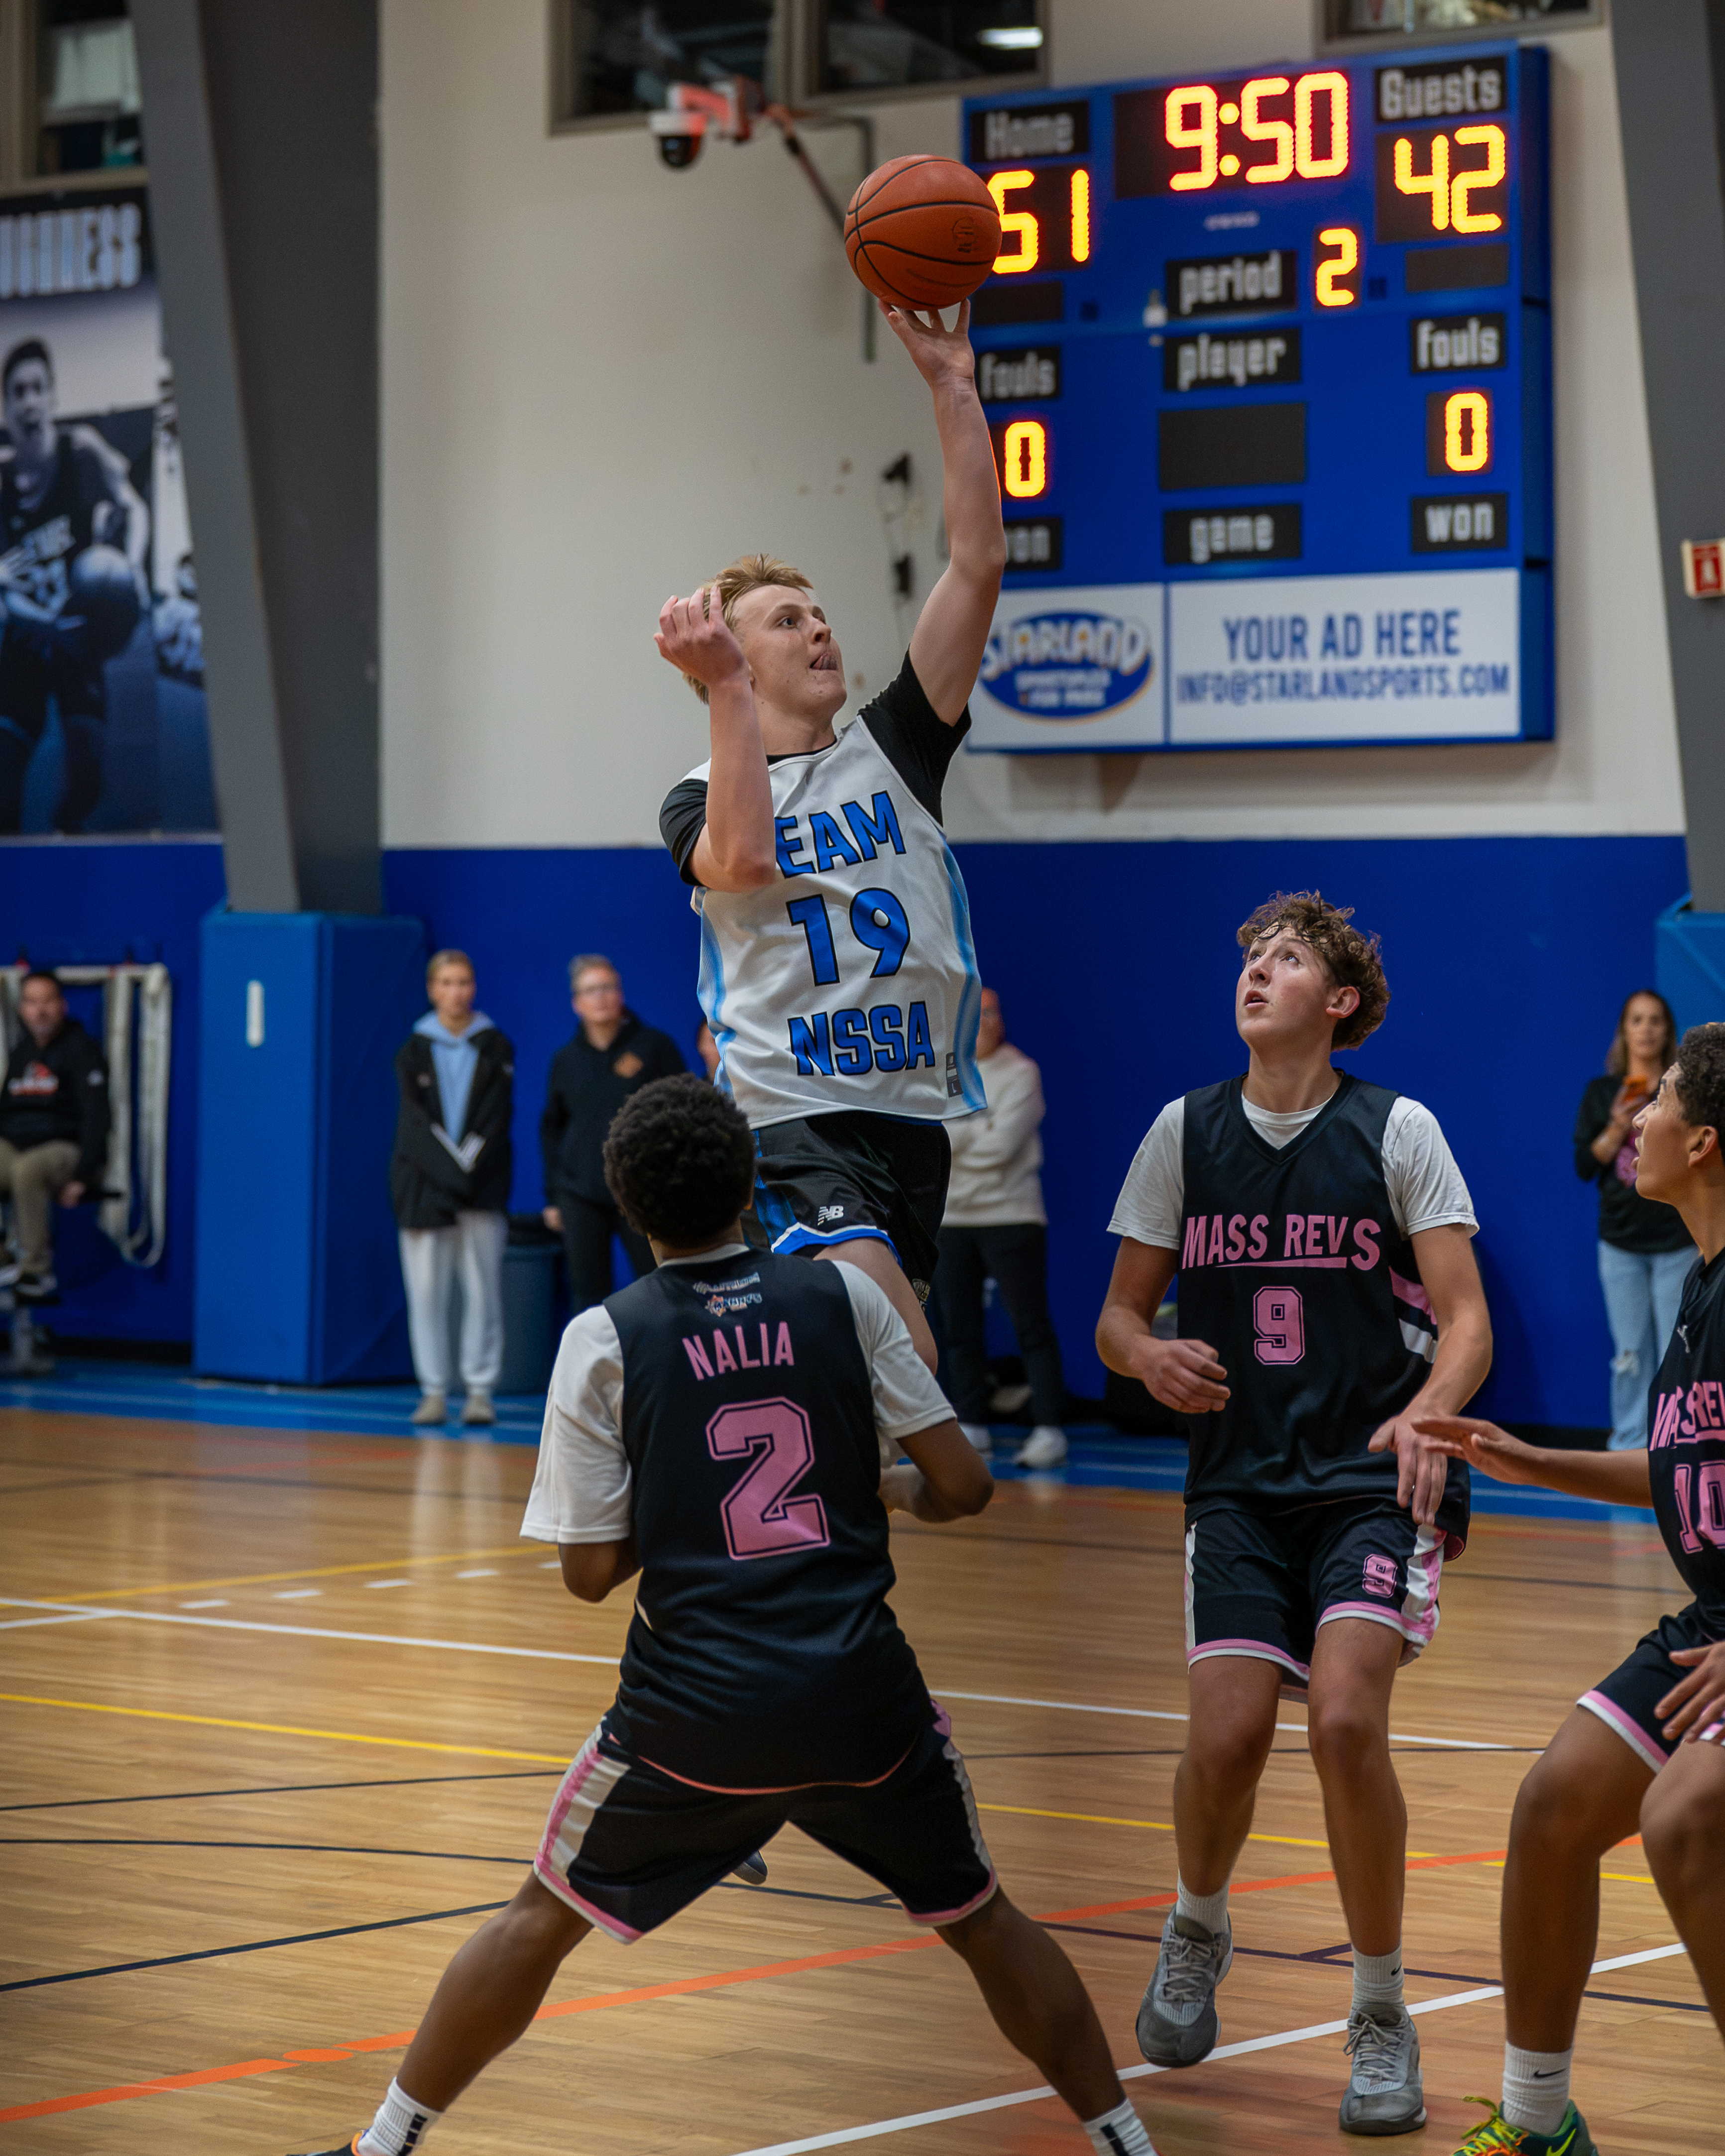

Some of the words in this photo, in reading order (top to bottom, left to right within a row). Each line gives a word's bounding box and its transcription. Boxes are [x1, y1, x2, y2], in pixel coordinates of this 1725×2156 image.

[1380, 65, 1501, 120] Guests
[984, 112, 1074, 159] Home
[1165, 72, 1349, 191] 9:50
[1394, 124, 1505, 233] 42
[986, 169, 1089, 274] 51
[1179, 249, 1282, 315] period
[1316, 227, 1358, 307] 2
[979, 351, 1056, 399] fouls
[1177, 332, 1286, 392] player
[1416, 317, 1500, 369] fouls
[1004, 421, 1045, 497] 0
[1445, 392, 1488, 471] 0
[1004, 524, 1051, 564] on
[1189, 513, 1274, 564] game
[1424, 502, 1494, 543] won
[1223, 615, 1309, 663] YOUR
[1320, 612, 1363, 660] AD
[1375, 608, 1461, 658] HERE
[775, 790, 906, 879] EAM
[786, 887, 911, 987] 19
[787, 1001, 935, 1076] NSSA
[1182, 1214, 1270, 1269] MASS
[1283, 1214, 1381, 1271] REVS
[682, 1321, 795, 1381] NALIA
[1253, 1285, 1306, 1365] 9
[705, 1396, 830, 1560] 2
[1674, 1460, 1725, 1555] 10
[1362, 1553, 1398, 1598] 9
